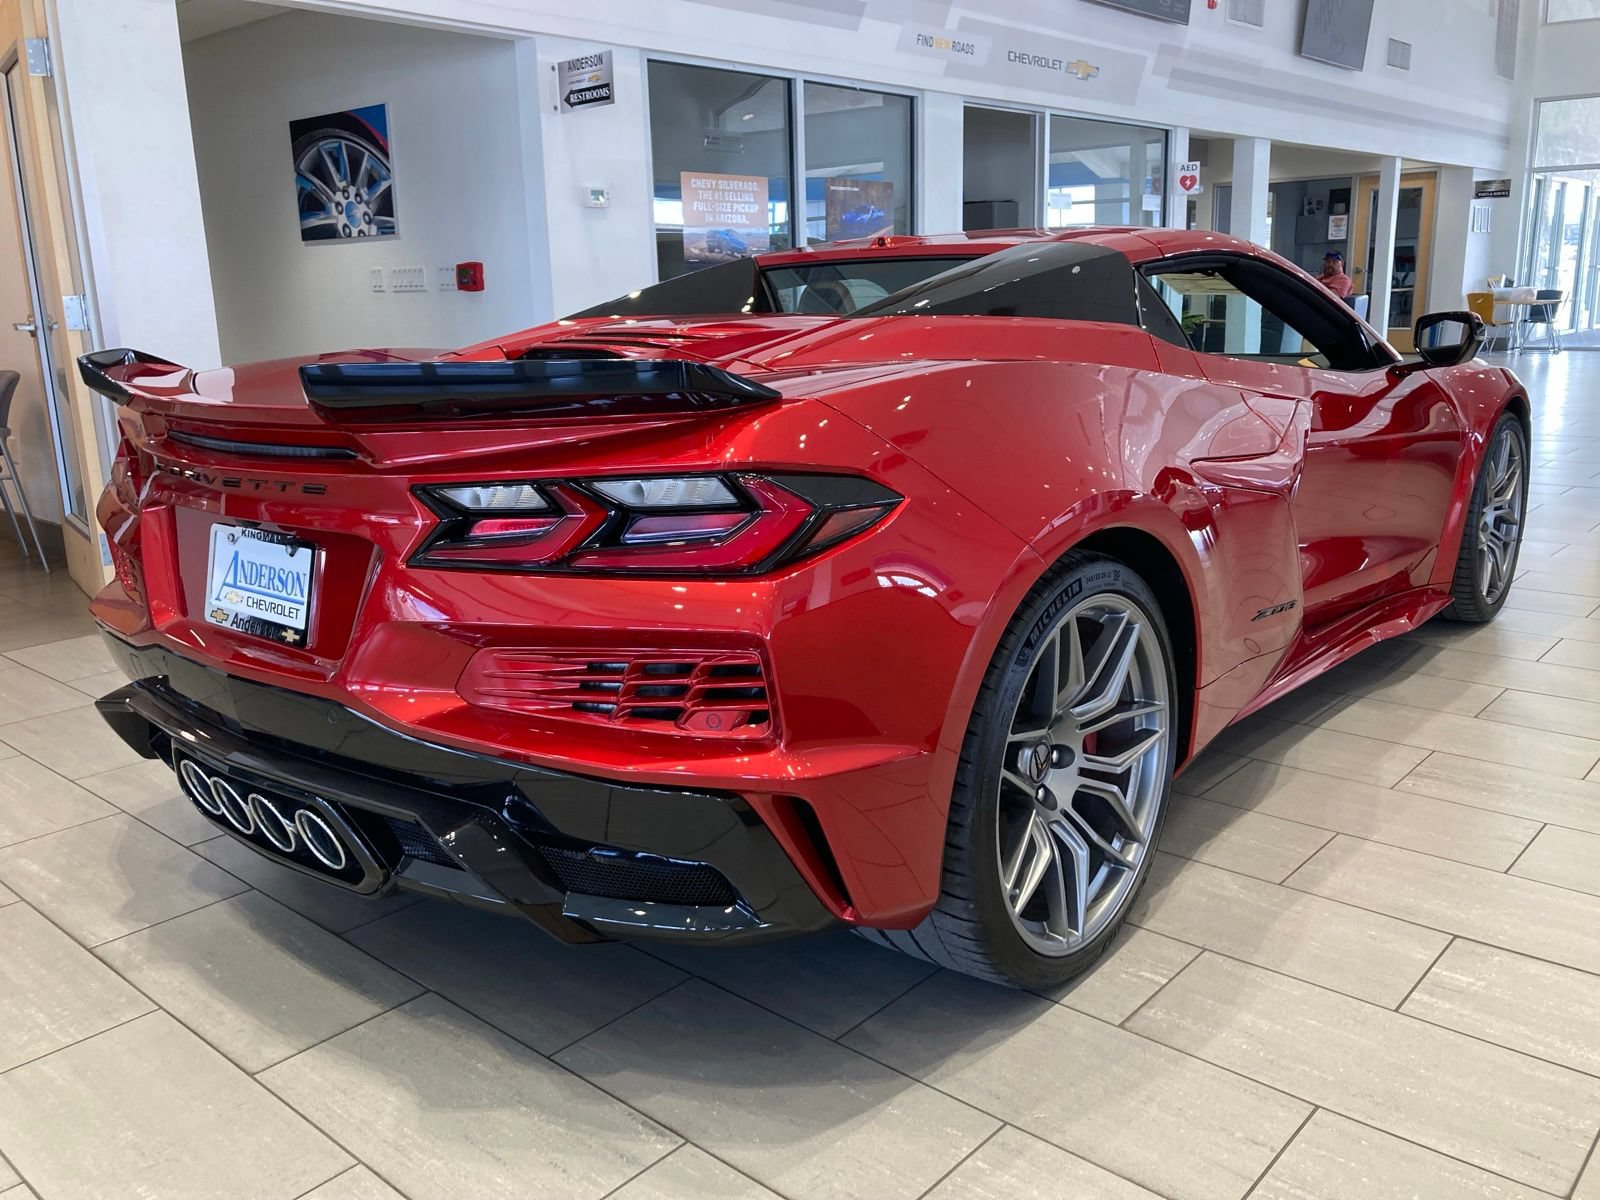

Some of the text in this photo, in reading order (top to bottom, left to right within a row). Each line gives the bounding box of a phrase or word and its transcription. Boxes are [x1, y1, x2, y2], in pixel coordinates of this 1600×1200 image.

[917, 34, 975, 55] FIND NEW ROADS
[567, 53, 603, 72] ANDERSON
[1007, 50, 1063, 71] CHEVROLET
[570, 87, 610, 103] RESTROOMS
[1180, 163, 1198, 171] AED
[690, 178, 760, 191] CHEVY SILVERADO.
[698, 190, 713, 200] THE
[724, 192, 754, 202] SELLING
[693, 201, 759, 213] FULL-SIZE PICKUP
[705, 213, 713, 222] IN
[156, 463, 327, 495] CORVETTE
[215, 550, 307, 601] ANDERSON
[246, 596, 300, 620] CHEVROLET
[1029, 581, 1081, 645] MICHELIN
